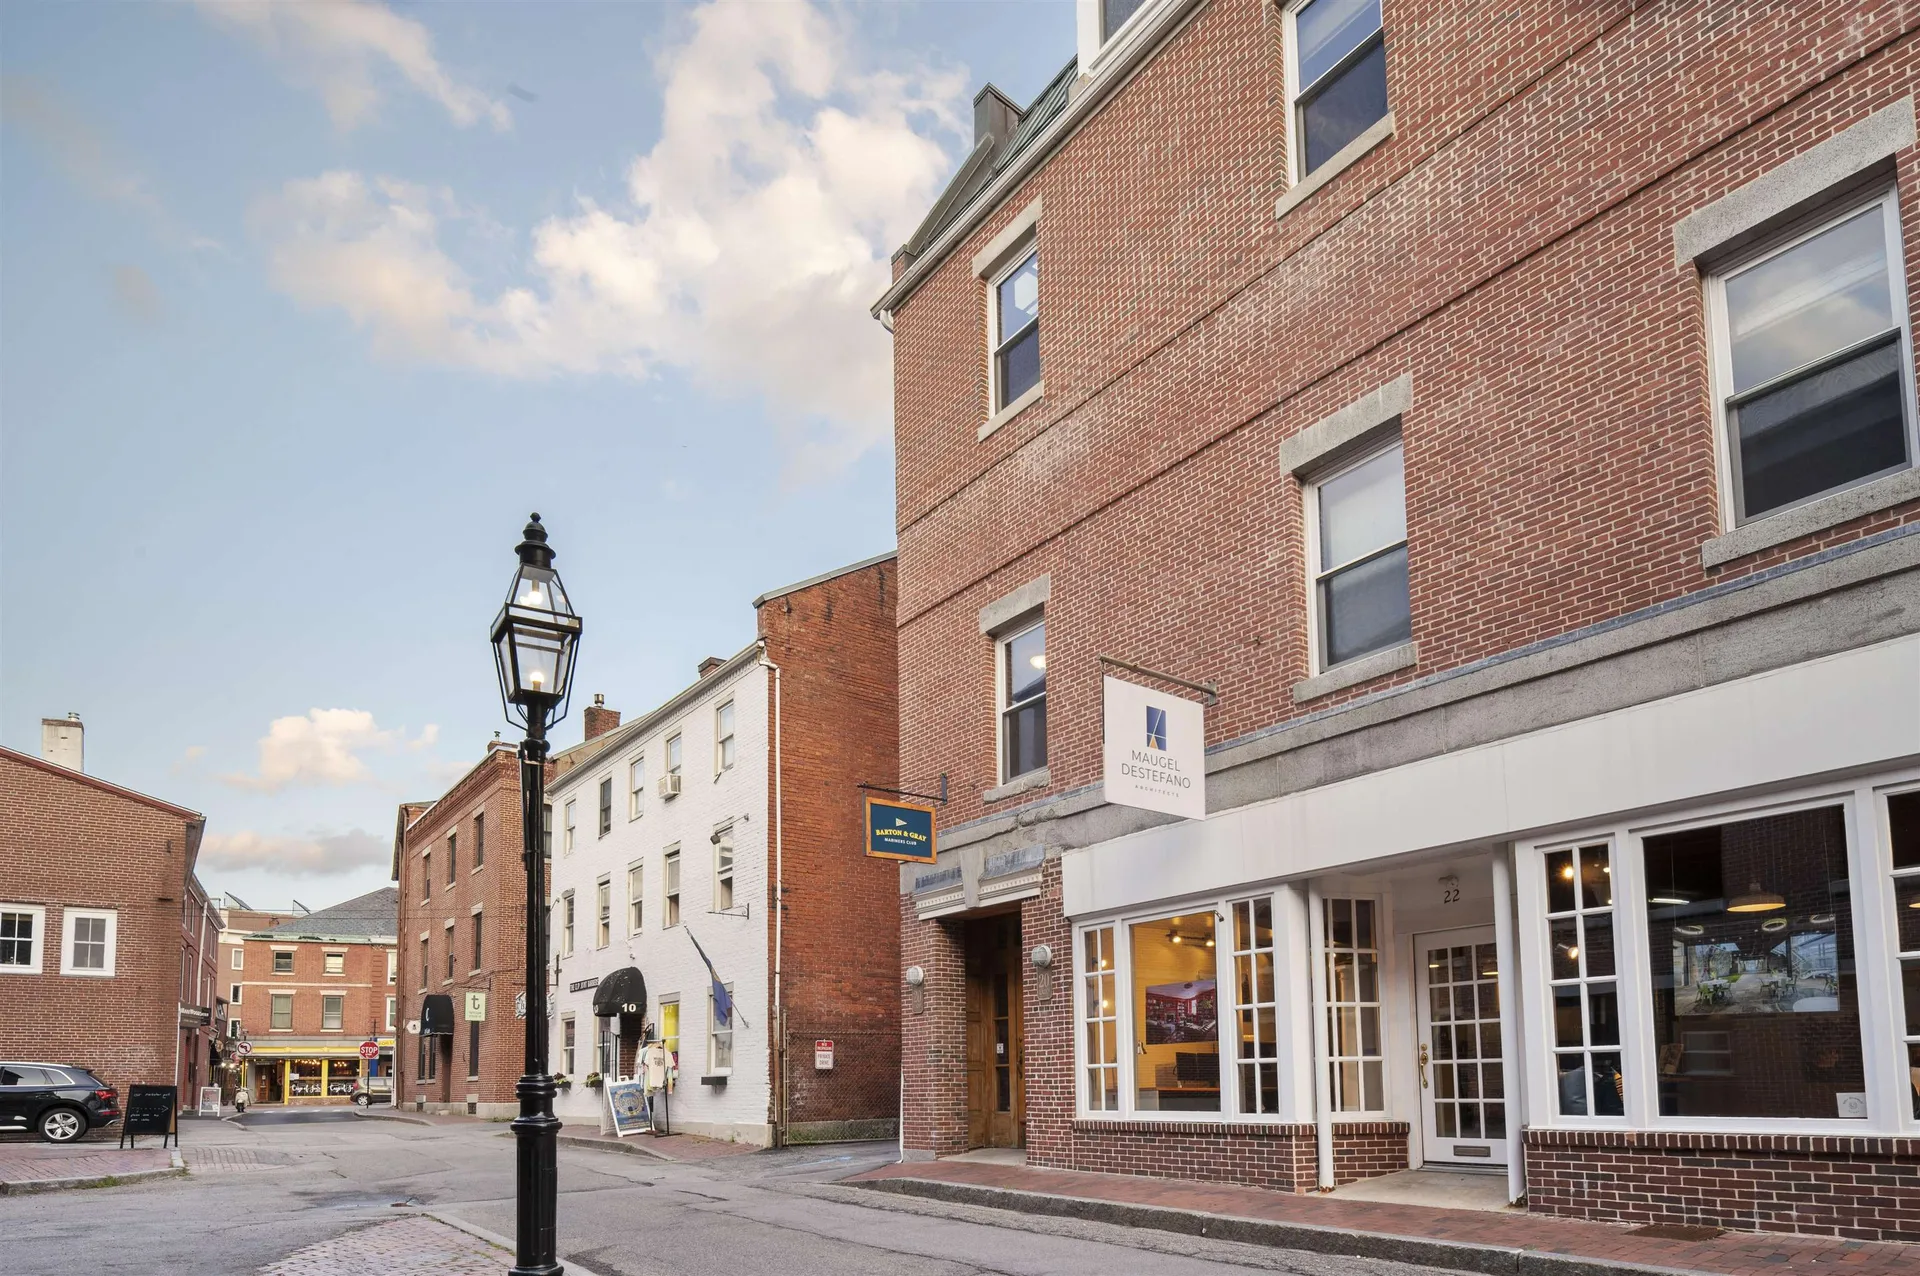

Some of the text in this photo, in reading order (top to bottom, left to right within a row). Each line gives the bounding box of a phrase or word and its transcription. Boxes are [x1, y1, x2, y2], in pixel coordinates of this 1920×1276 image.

[1131, 750, 1180, 772] MAUGEL
[1121, 763, 1191, 789] DESTEFANO
[1135, 784, 1179, 798] ARCHITECTS
[909, 832, 927, 841] GRAY
[1443, 889, 1460, 904] 22
[1038, 973, 1050, 988] 20
[622, 1003, 637, 1012] 10
[360, 1046, 378, 1054] STOP
